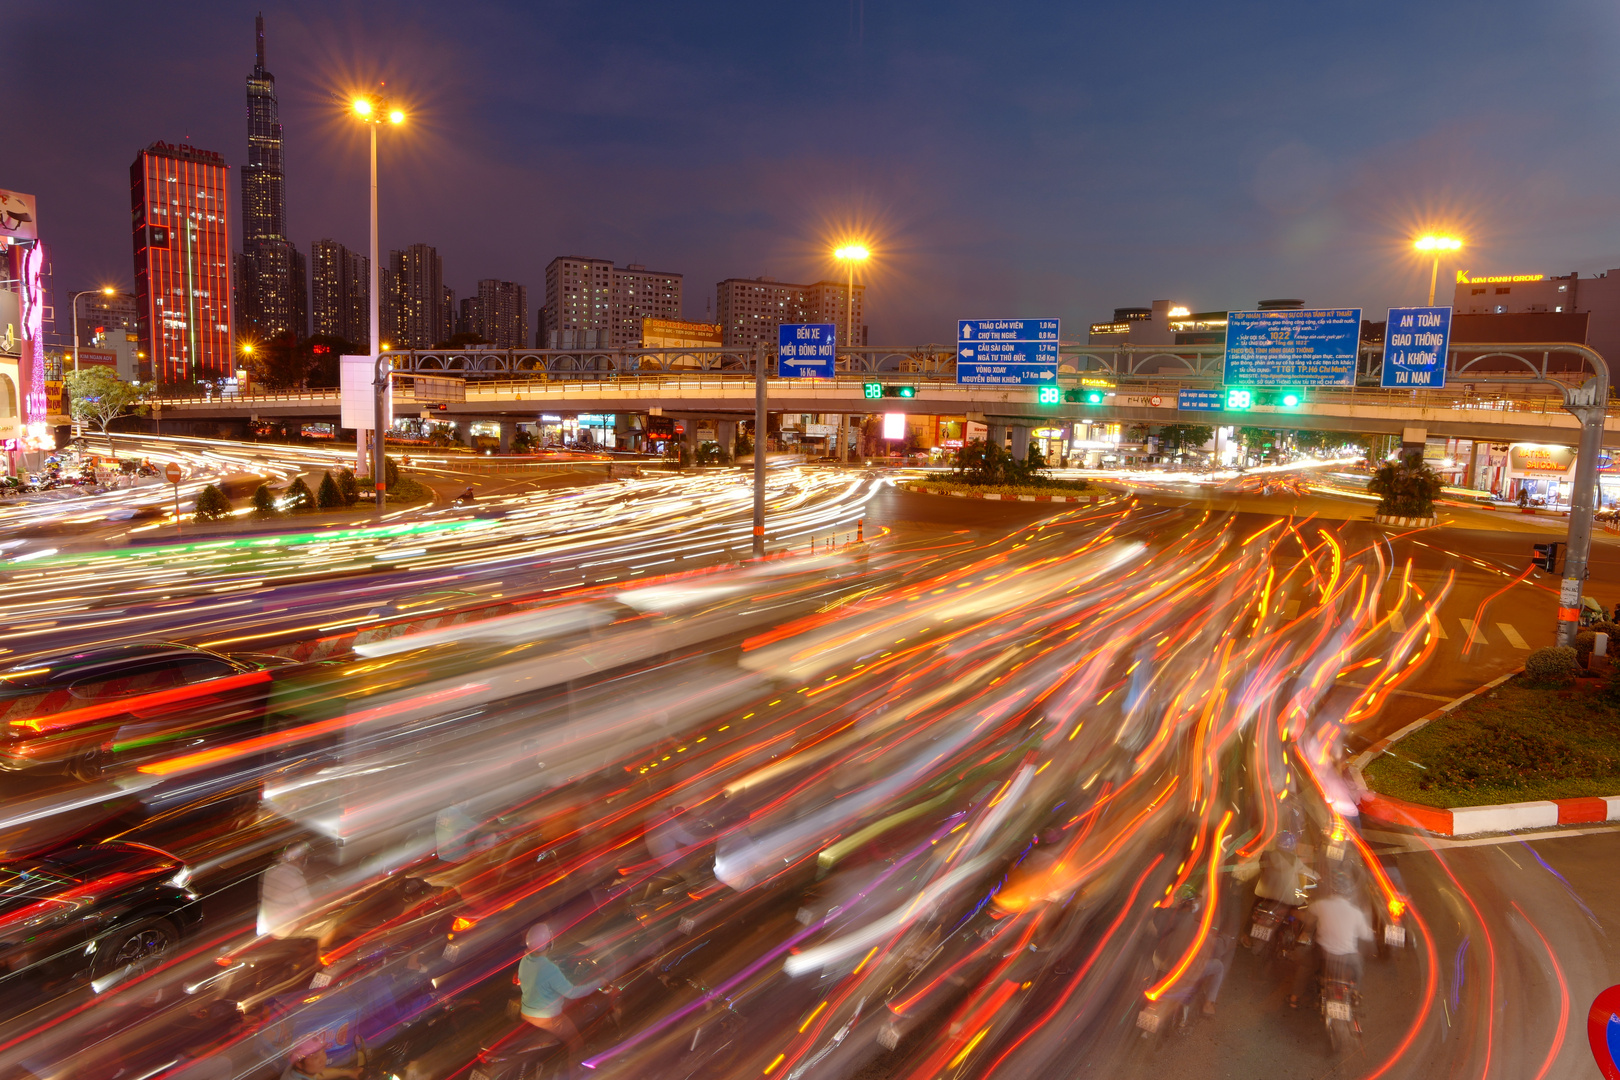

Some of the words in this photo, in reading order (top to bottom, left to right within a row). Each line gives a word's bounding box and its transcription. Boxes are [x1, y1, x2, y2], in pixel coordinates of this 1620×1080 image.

[1513, 274, 1543, 282] GROUP
[1400, 315, 1413, 327] AN
[1418, 312, 1441, 327] TOÀN
[979, 320, 994, 329] THẢO
[1009, 321, 1023, 329] VIÊN
[797, 325, 810, 339] BẾN
[811, 328, 820, 339] XE
[978, 332, 990, 340] CHỢ
[1001, 331, 1017, 339] NGHÈ
[1270, 332, 1290, 340] 1022
[1391, 334, 1412, 346] GIAO
[1415, 332, 1443, 346] THÔNG
[781, 341, 796, 356] MIỀN
[799, 343, 817, 356] ĐÔNG
[819, 341, 832, 356] MỚI
[978, 343, 989, 351] CẦU
[990, 343, 1000, 351] SÀI
[1001, 343, 1014, 351] GÒN
[1000, 353, 1012, 361] THỦ
[1013, 353, 1026, 361] ĐỨC
[1393, 350, 1405, 365] LÀ
[1407, 351, 1437, 365] KHÔNG
[800, 368, 806, 376] 16
[807, 368, 817, 376] Km
[976, 365, 991, 373] VÒNG
[962, 374, 985, 382] NGUYỄN
[1396, 372, 1409, 383] TAI
[1411, 372, 1431, 386] NẠN
